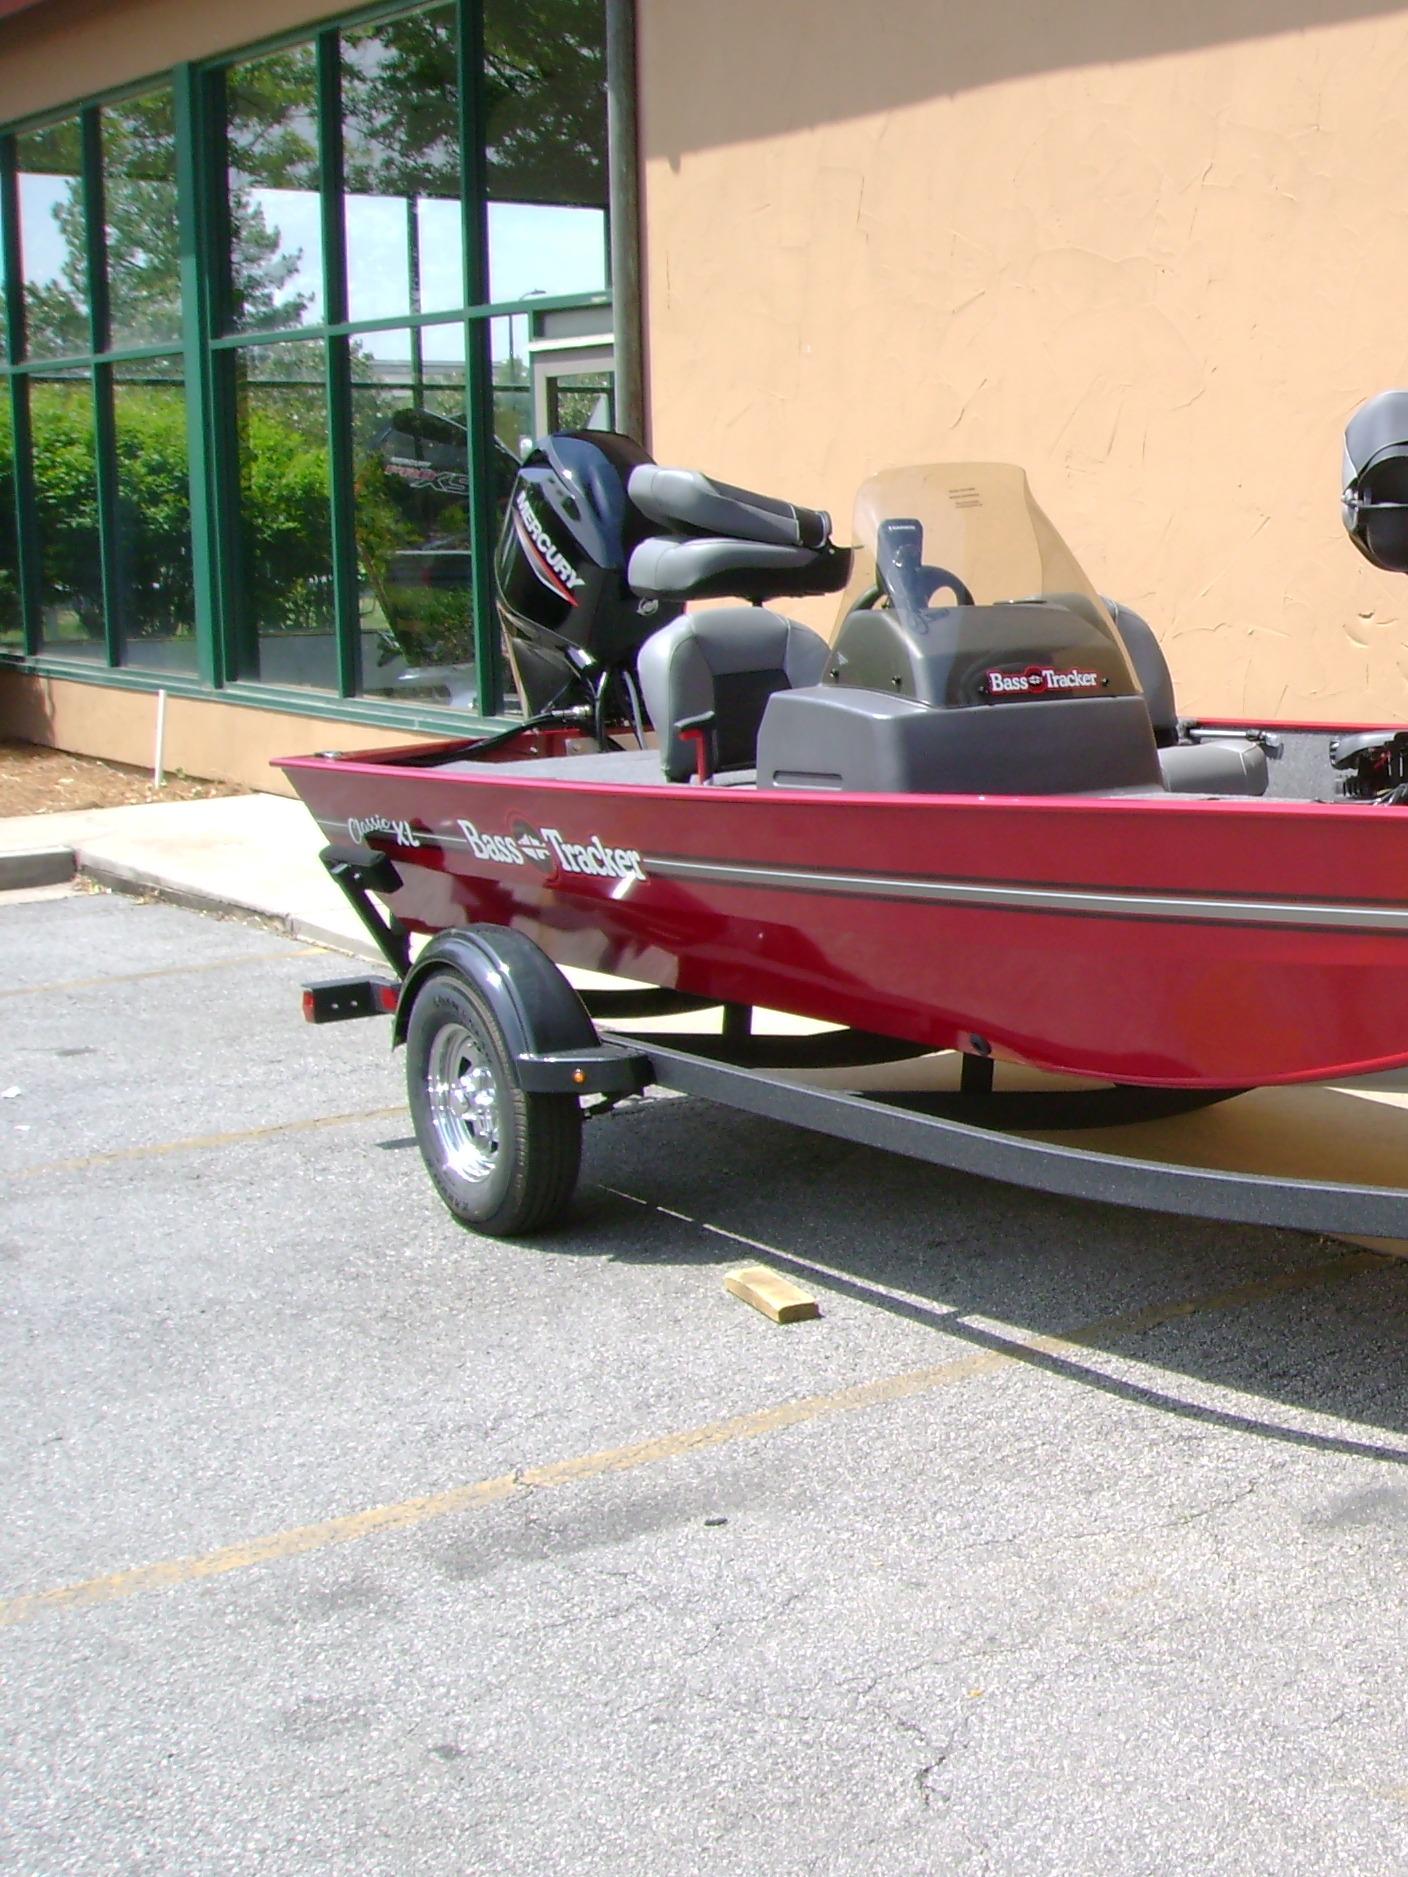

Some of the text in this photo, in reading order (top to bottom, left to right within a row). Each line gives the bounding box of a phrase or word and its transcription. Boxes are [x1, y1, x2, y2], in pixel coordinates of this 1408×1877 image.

[516, 490, 585, 589] MERCURY
[989, 669, 1097, 692] Bass Tracker
[348, 814, 390, 845] Classic
[458, 819, 646, 880] Bass Tracker
